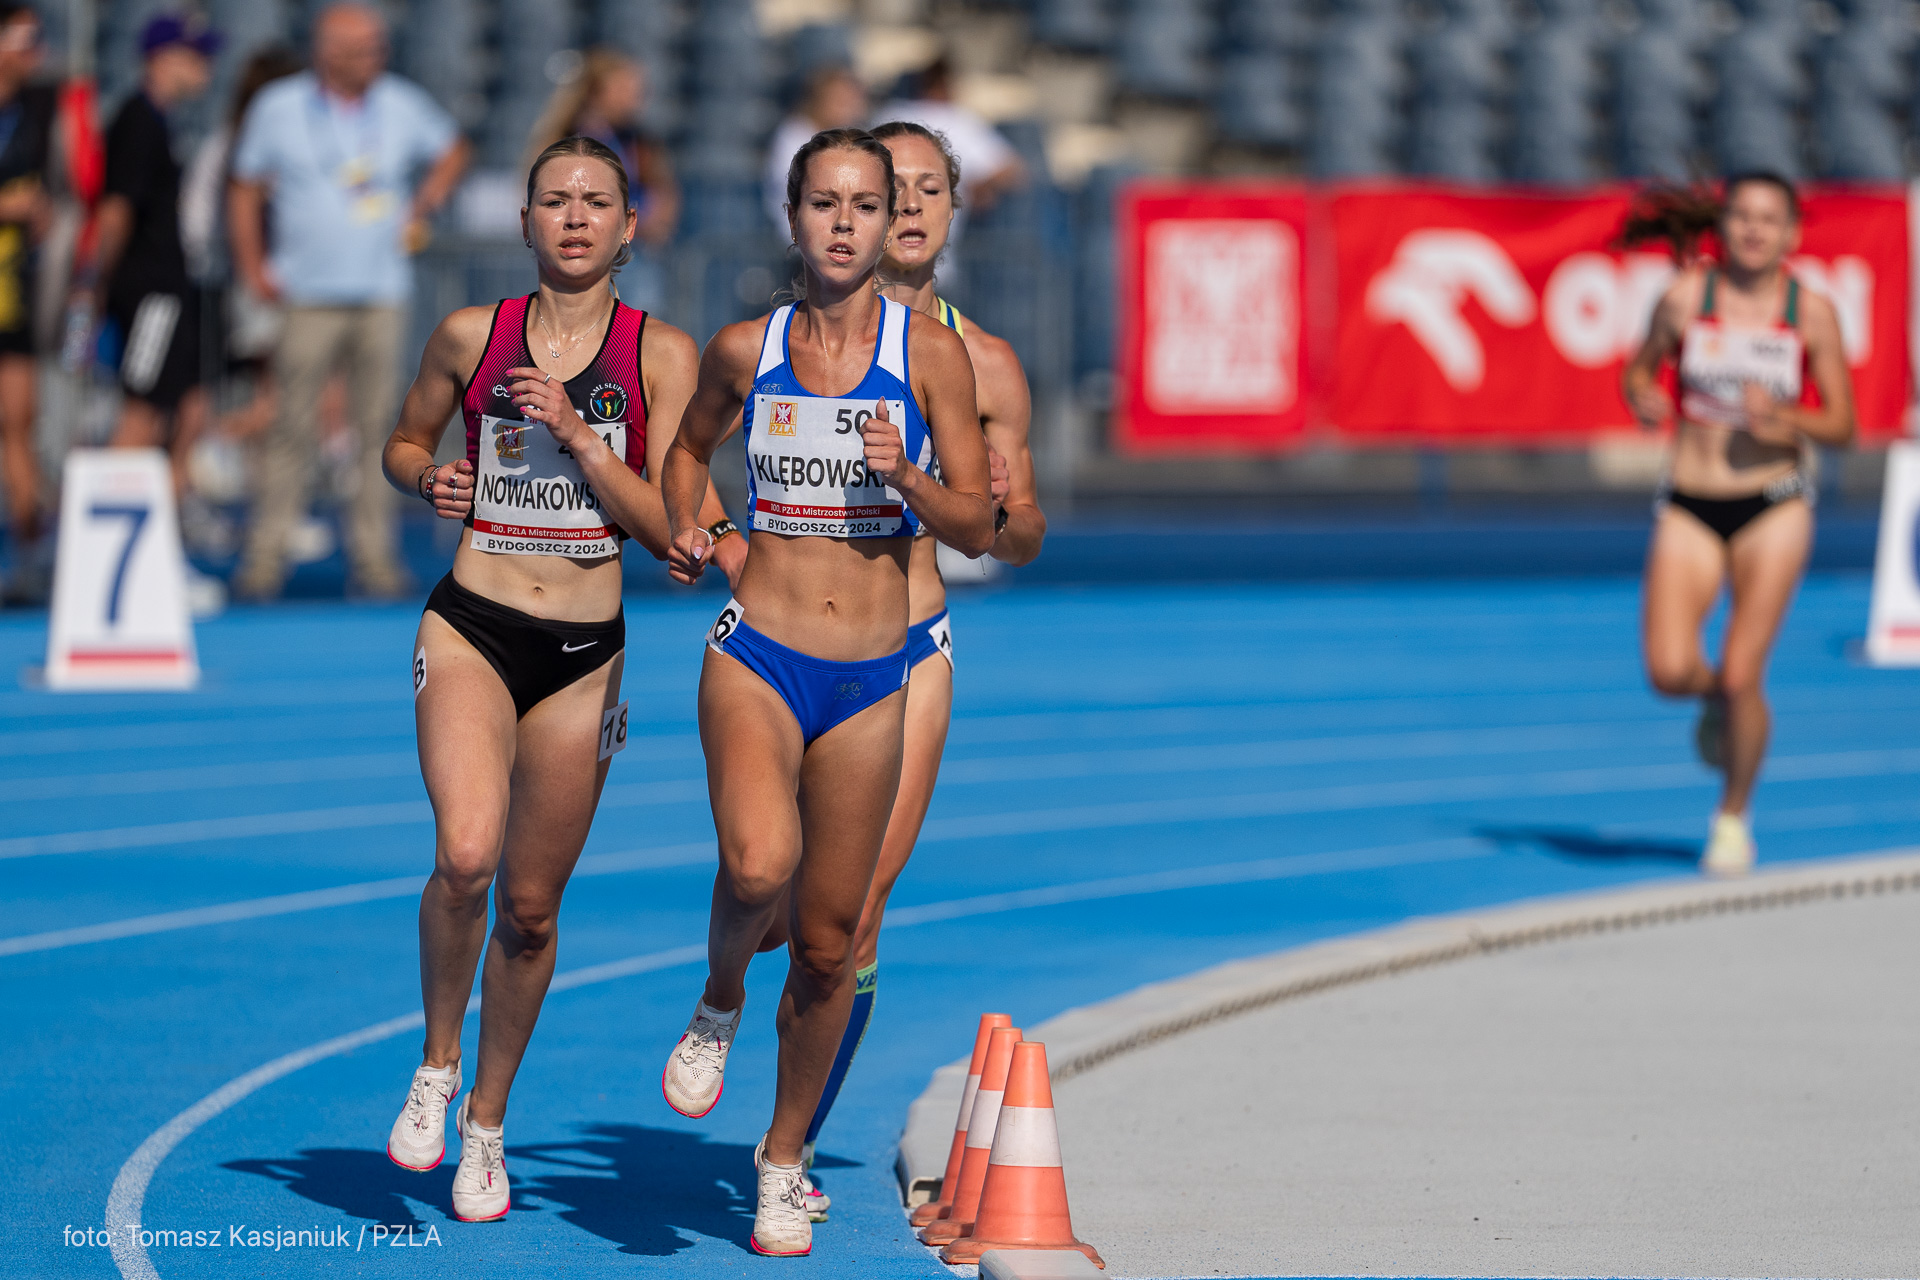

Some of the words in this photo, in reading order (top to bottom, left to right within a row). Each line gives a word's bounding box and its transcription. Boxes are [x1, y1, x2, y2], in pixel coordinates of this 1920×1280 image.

[770, 424, 794, 435] PZLA
[834, 408, 890, 435] 50
[497, 445, 522, 459] PZLA
[754, 453, 886, 492] KLĘBOWSK
[480, 473, 600, 511] NOWAKOWS
[770, 503, 781, 514] 100.
[782, 506, 801, 515] PZLA
[802, 507, 855, 517] Mistrzostwa
[856, 507, 881, 517] Polski
[490, 524, 505, 534] 100.
[507, 526, 527, 536] PZLA
[528, 528, 581, 538] Mistrzostwa
[582, 528, 605, 538] Polski
[767, 518, 846, 534] BYDGOSZCZ
[849, 521, 882, 533] 2024
[487, 539, 571, 554] BYDGOSZCZ
[575, 542, 606, 555] 2024
[86, 500, 152, 628] 7
[709, 608, 737, 643] 6
[603, 707, 628, 750] 18
